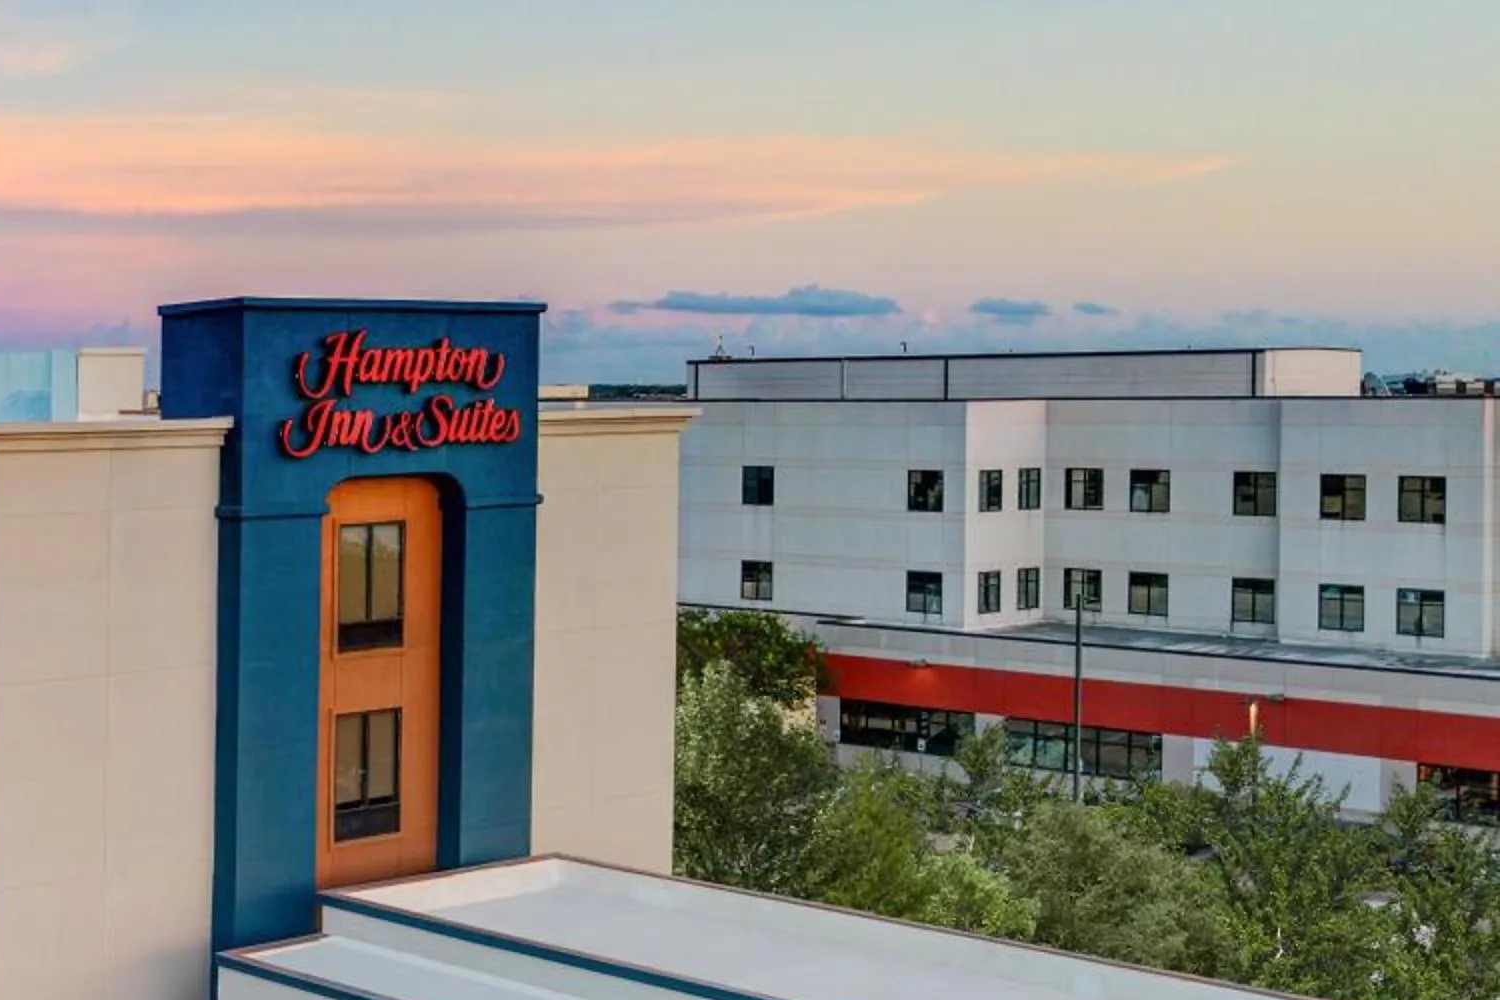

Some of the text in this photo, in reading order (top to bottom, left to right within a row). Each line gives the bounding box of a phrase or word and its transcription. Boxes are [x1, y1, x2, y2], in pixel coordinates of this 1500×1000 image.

[300, 328, 504, 398] Hampton
[283, 395, 521, 457] Inn & Suites
